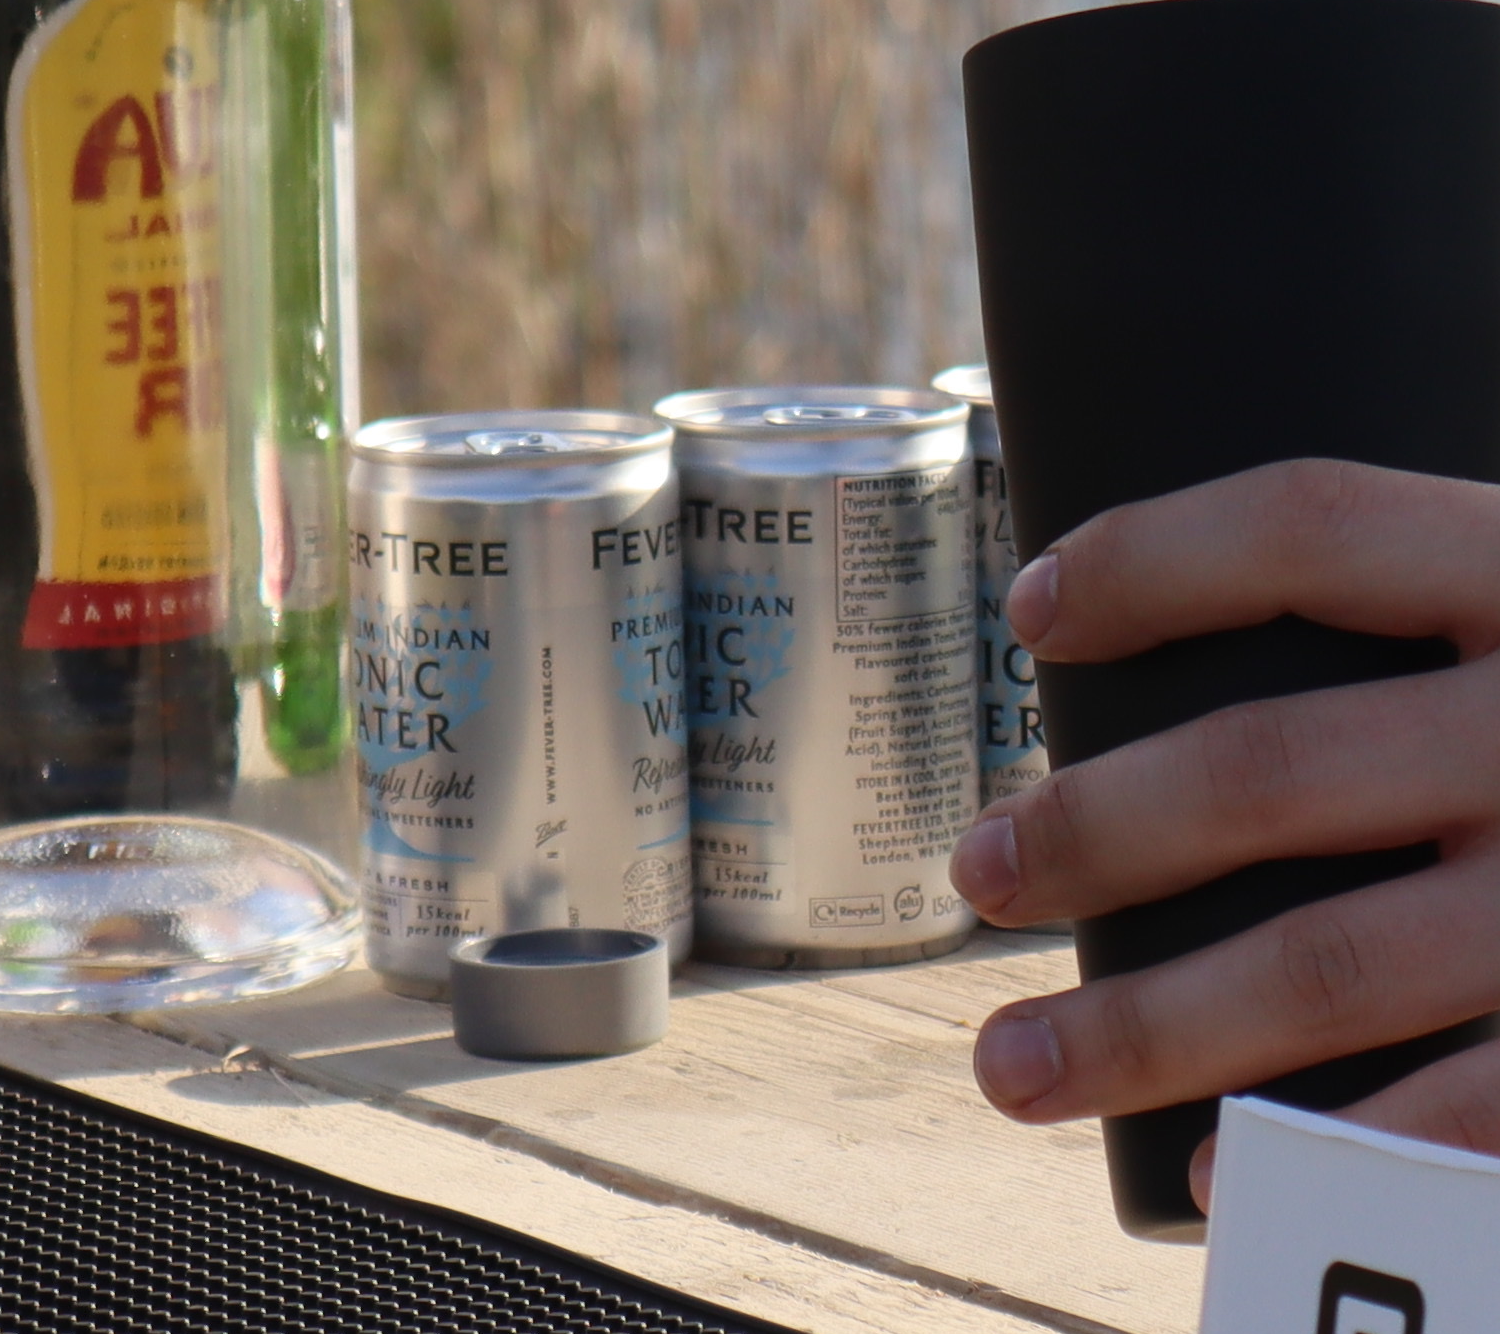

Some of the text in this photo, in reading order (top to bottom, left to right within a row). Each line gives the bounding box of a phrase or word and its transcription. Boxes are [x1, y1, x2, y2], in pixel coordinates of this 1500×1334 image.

[843, 476, 916, 493] NUTRITION
[843, 528, 871, 541] Total
[591, 521, 682, 570] FEVE
[842, 542, 890, 556] of which
[842, 573, 891, 587] of which
[610, 611, 680, 643] PREMI
[836, 624, 864, 638] 50%
[868, 622, 904, 635] fewer
[386, 625, 491, 652] INDIAN
[832, 641, 892, 654] Premium
[896, 636, 931, 650] Indian
[854, 654, 919, 670] Flavoured
[894, 671, 918, 683] soft
[850, 691, 925, 708] Ingredients:
[542, 646, 558, 805] WWW.FEVER-TREE.COM
[855, 710, 897, 725] Spring
[848, 727, 885, 743] (Fruit
[711, 732, 776, 773] Light
[887, 736, 931, 754] Natural
[871, 755, 927, 772] including
[411, 768, 476, 809] Light
[856, 777, 888, 790] STORE
[904, 775, 911, 786] A
[876, 785, 943, 803] Best before
[635, 804, 653, 818] NO
[878, 809, 900, 819] see
[903, 803, 930, 816] base
[384, 810, 475, 830] SWEETENERS
[853, 819, 922, 835] FEVERTREE
[859, 833, 925, 850] Shepherds
[714, 867, 769, 884] 15kcal
[388, 875, 450, 894] FRESH
[703, 887, 783, 902] per 100ml
[899, 895, 920, 908] alu
[416, 904, 471, 922] 15kcal
[838, 904, 881, 919] Recycle
[406, 925, 430, 938] per
